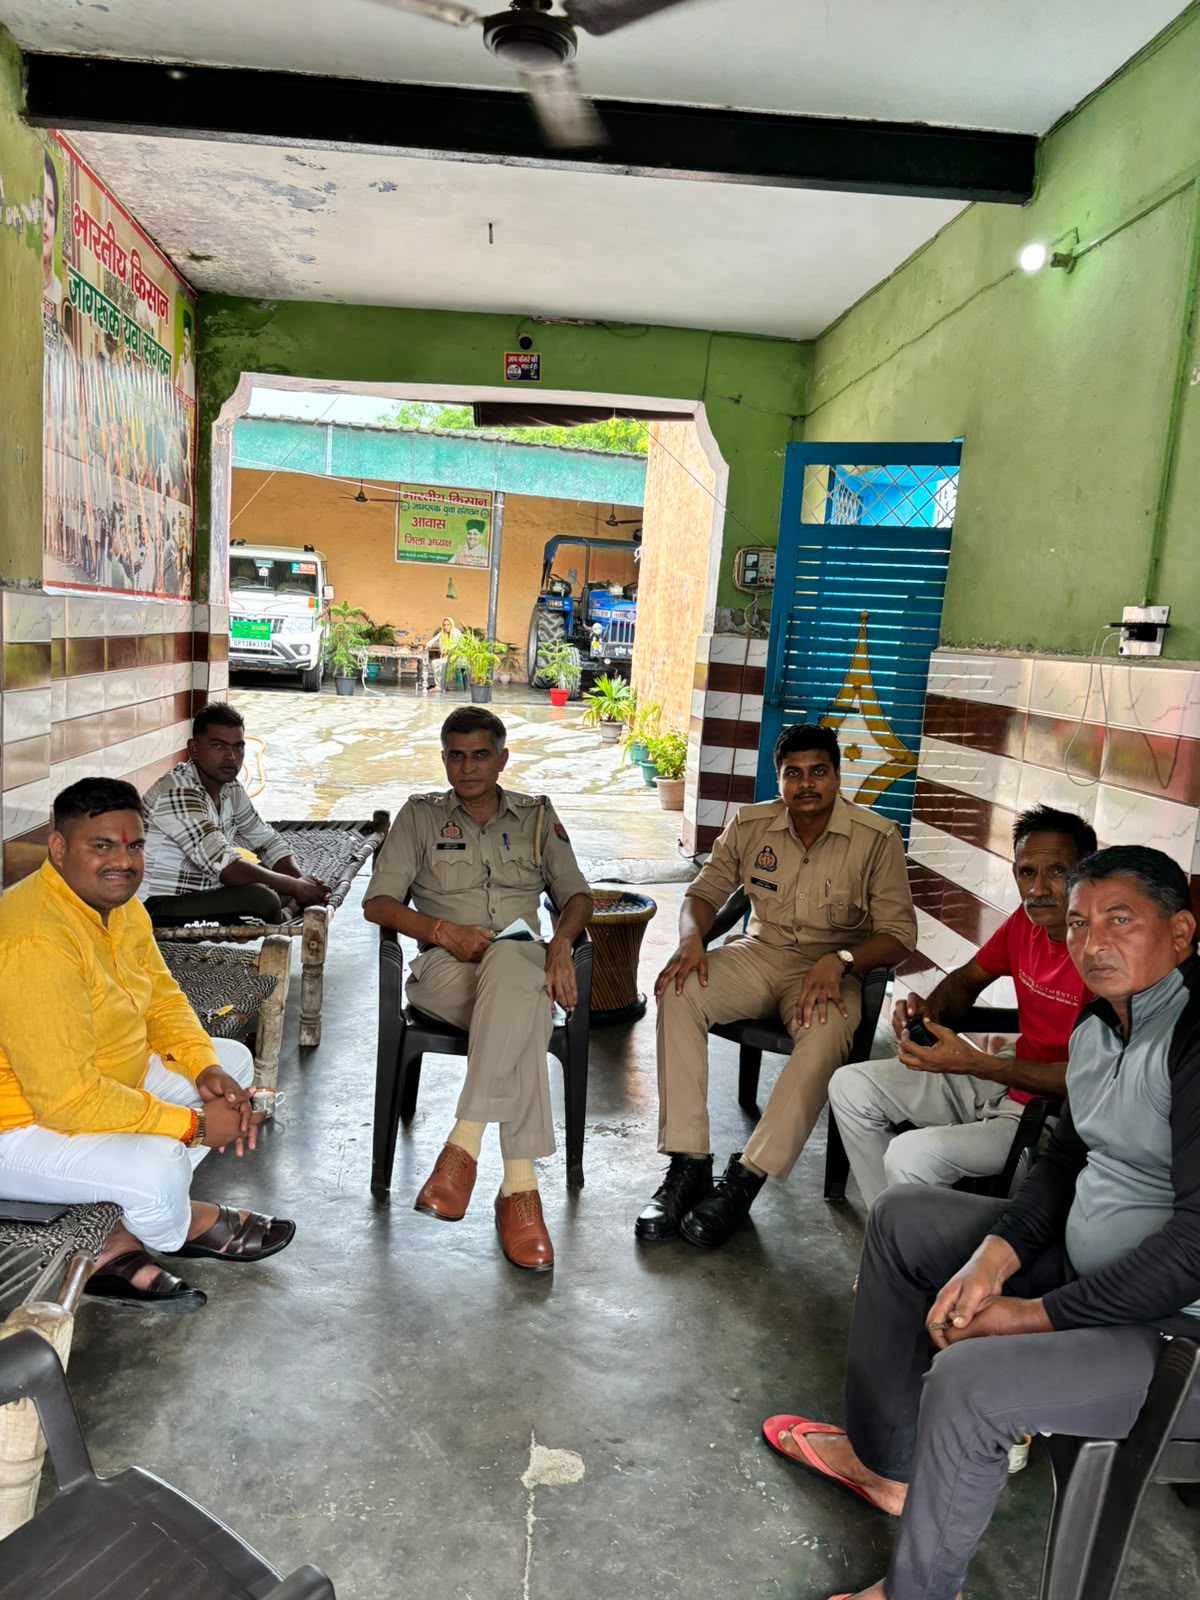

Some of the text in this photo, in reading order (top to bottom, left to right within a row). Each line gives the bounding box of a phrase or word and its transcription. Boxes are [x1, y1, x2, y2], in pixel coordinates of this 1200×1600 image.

[73, 201, 169, 324] भारतीय किसान
[67, 264, 172, 378] जागरूक युवा संगठन
[403, 490, 445, 503] भारतीय
[448, 492, 487, 507] किसान
[411, 517, 446, 530] आवास
[404, 533, 452, 547] जिला अध्यक्ष
[1035, 983, 1079, 1002] AUTHENTIC
